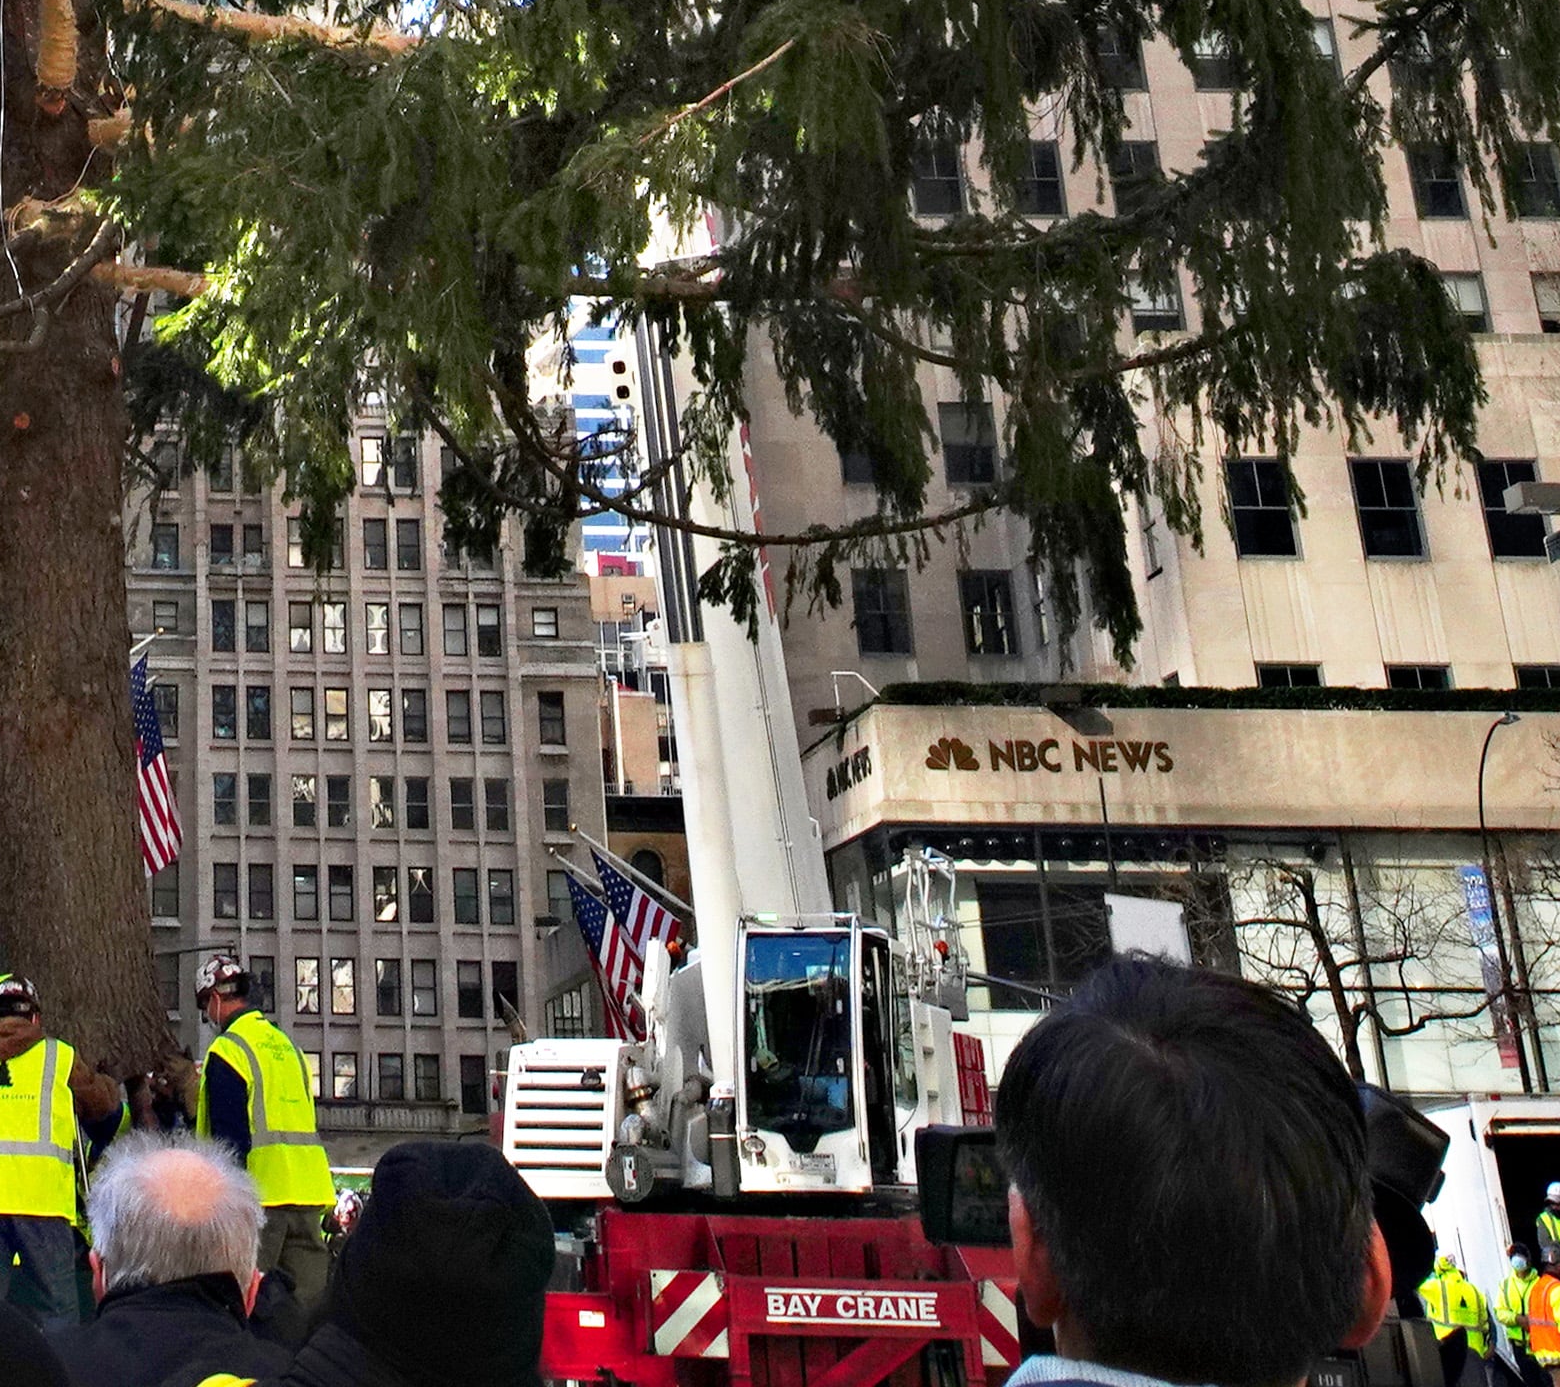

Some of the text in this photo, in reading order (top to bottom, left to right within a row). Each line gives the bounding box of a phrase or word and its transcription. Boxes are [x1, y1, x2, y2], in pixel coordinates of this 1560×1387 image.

[988, 738, 1174, 774] NBC NEWS
[766, 1294, 938, 1320] BAY CRANE
